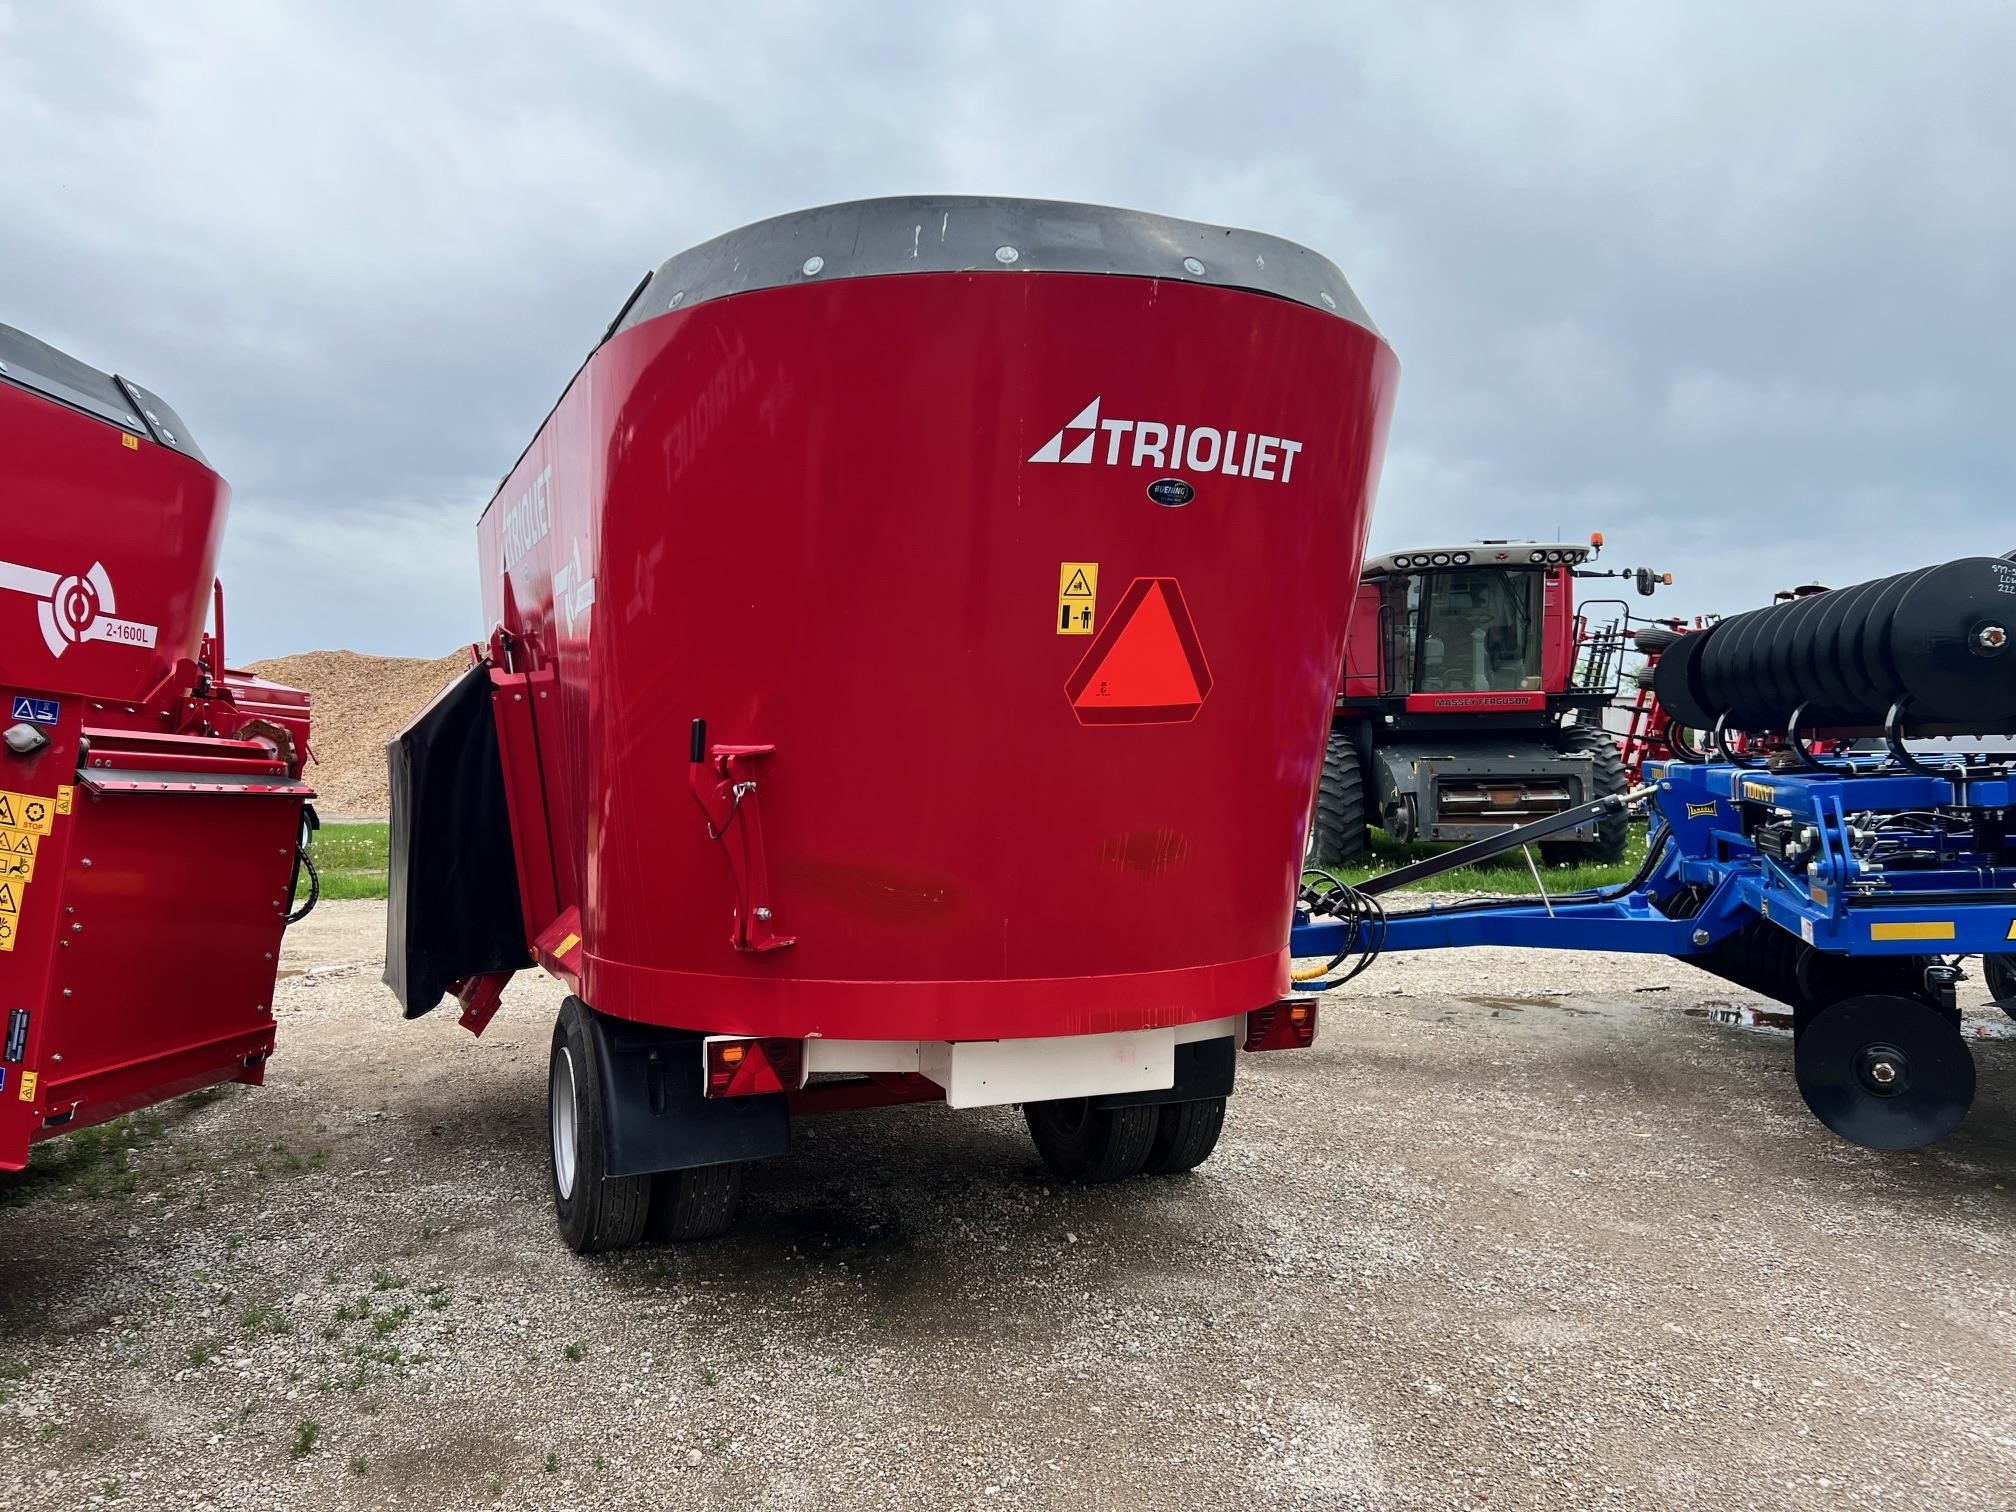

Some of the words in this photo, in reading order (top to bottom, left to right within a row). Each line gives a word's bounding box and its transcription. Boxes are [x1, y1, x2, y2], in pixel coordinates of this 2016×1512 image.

[1101, 418, 1302, 483] TRIOLIET
[504, 463, 552, 570] TRIOLIET
[106, 622, 149, 643] 2-1600L
[1435, 699, 1476, 707] MASSEY
[1480, 697, 1529, 705] FERGUSON
[23, 821, 43, 831] STOP
